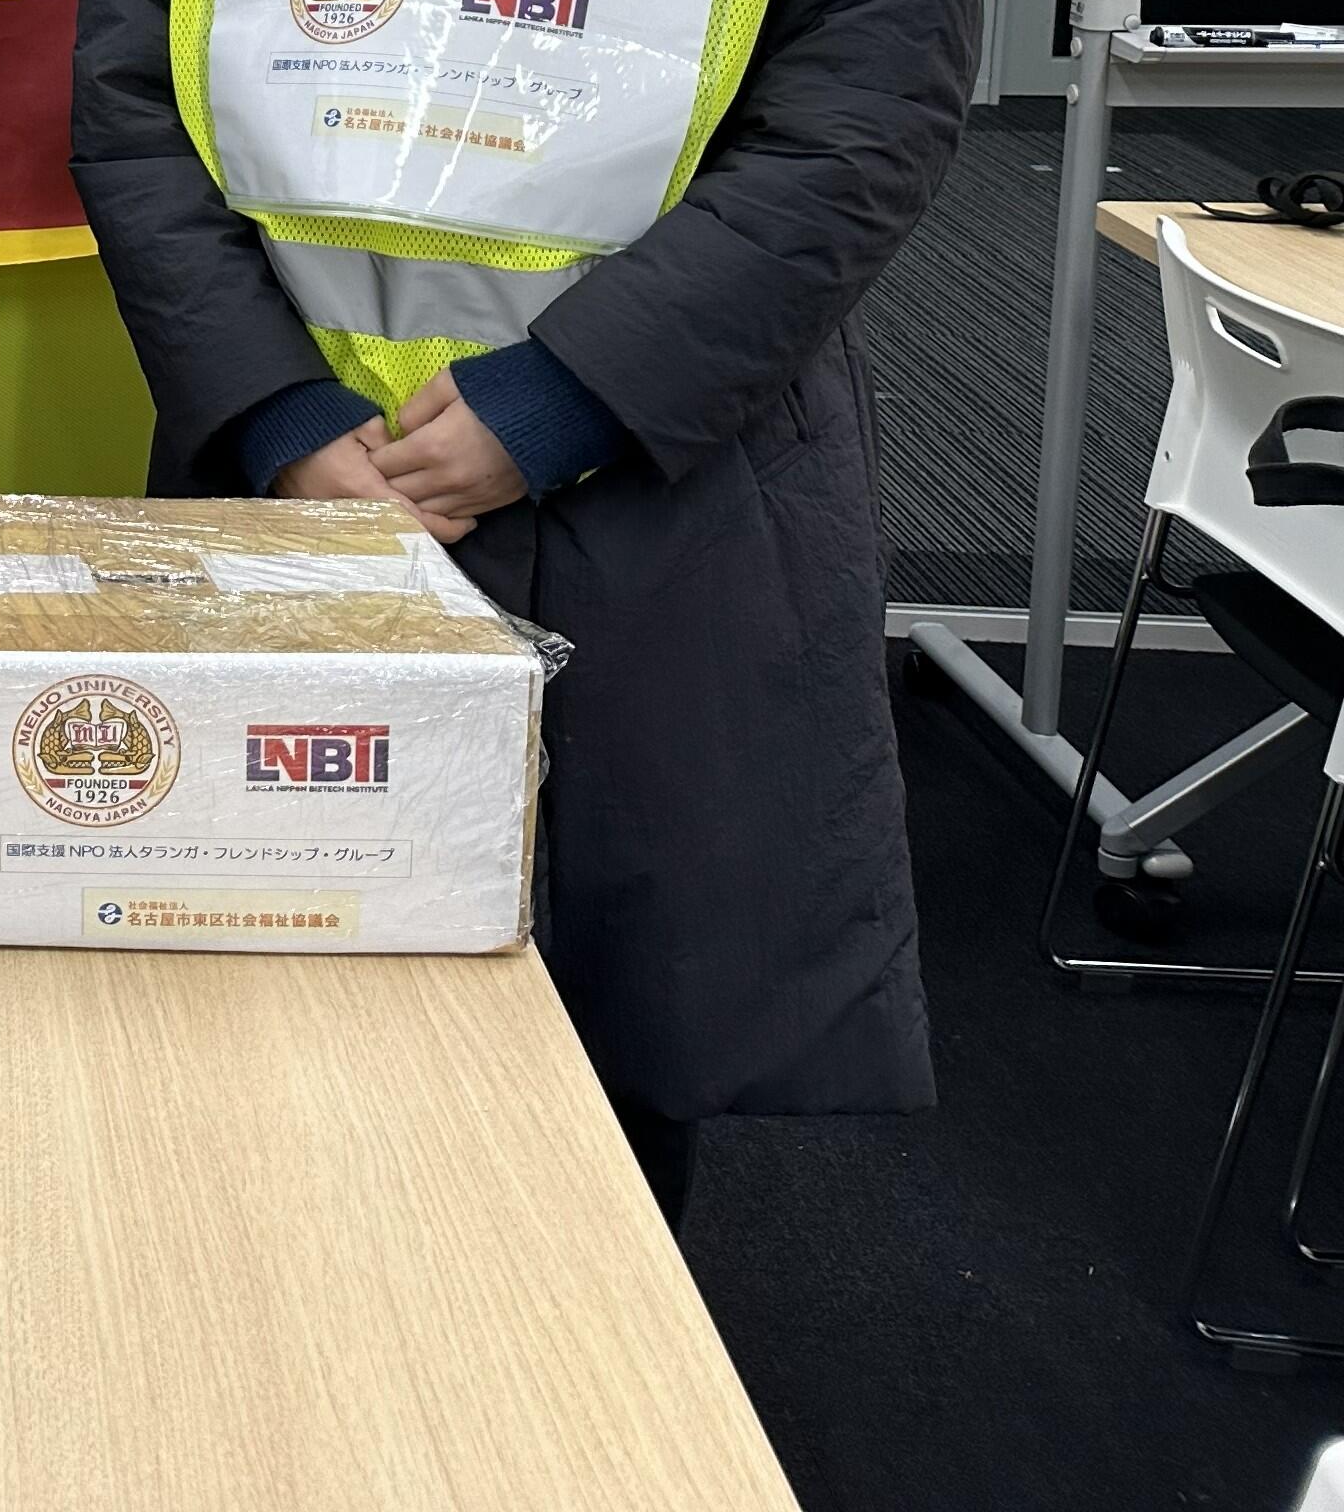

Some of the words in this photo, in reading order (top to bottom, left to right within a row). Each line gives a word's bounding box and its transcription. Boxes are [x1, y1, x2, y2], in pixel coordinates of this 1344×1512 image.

[319, 3, 362, 13] FOUNDED
[323, 12, 354, 24] 1926
[340, 19, 375, 40] JAPAN
[17, 691, 62, 747] MEIJO
[66, 680, 176, 749] UNIVERSITY
[246, 724, 390, 783] LNBTI
[66, 778, 128, 790] FOUNDED
[74, 789, 121, 804] 1926
[45, 796, 101, 823] NAGOYA
[104, 797, 148, 822] JAPAN
[127, 900, 189, 912] 社会福祉法人
[126, 911, 341, 929] 名古屋市東区社会福祉協議会
